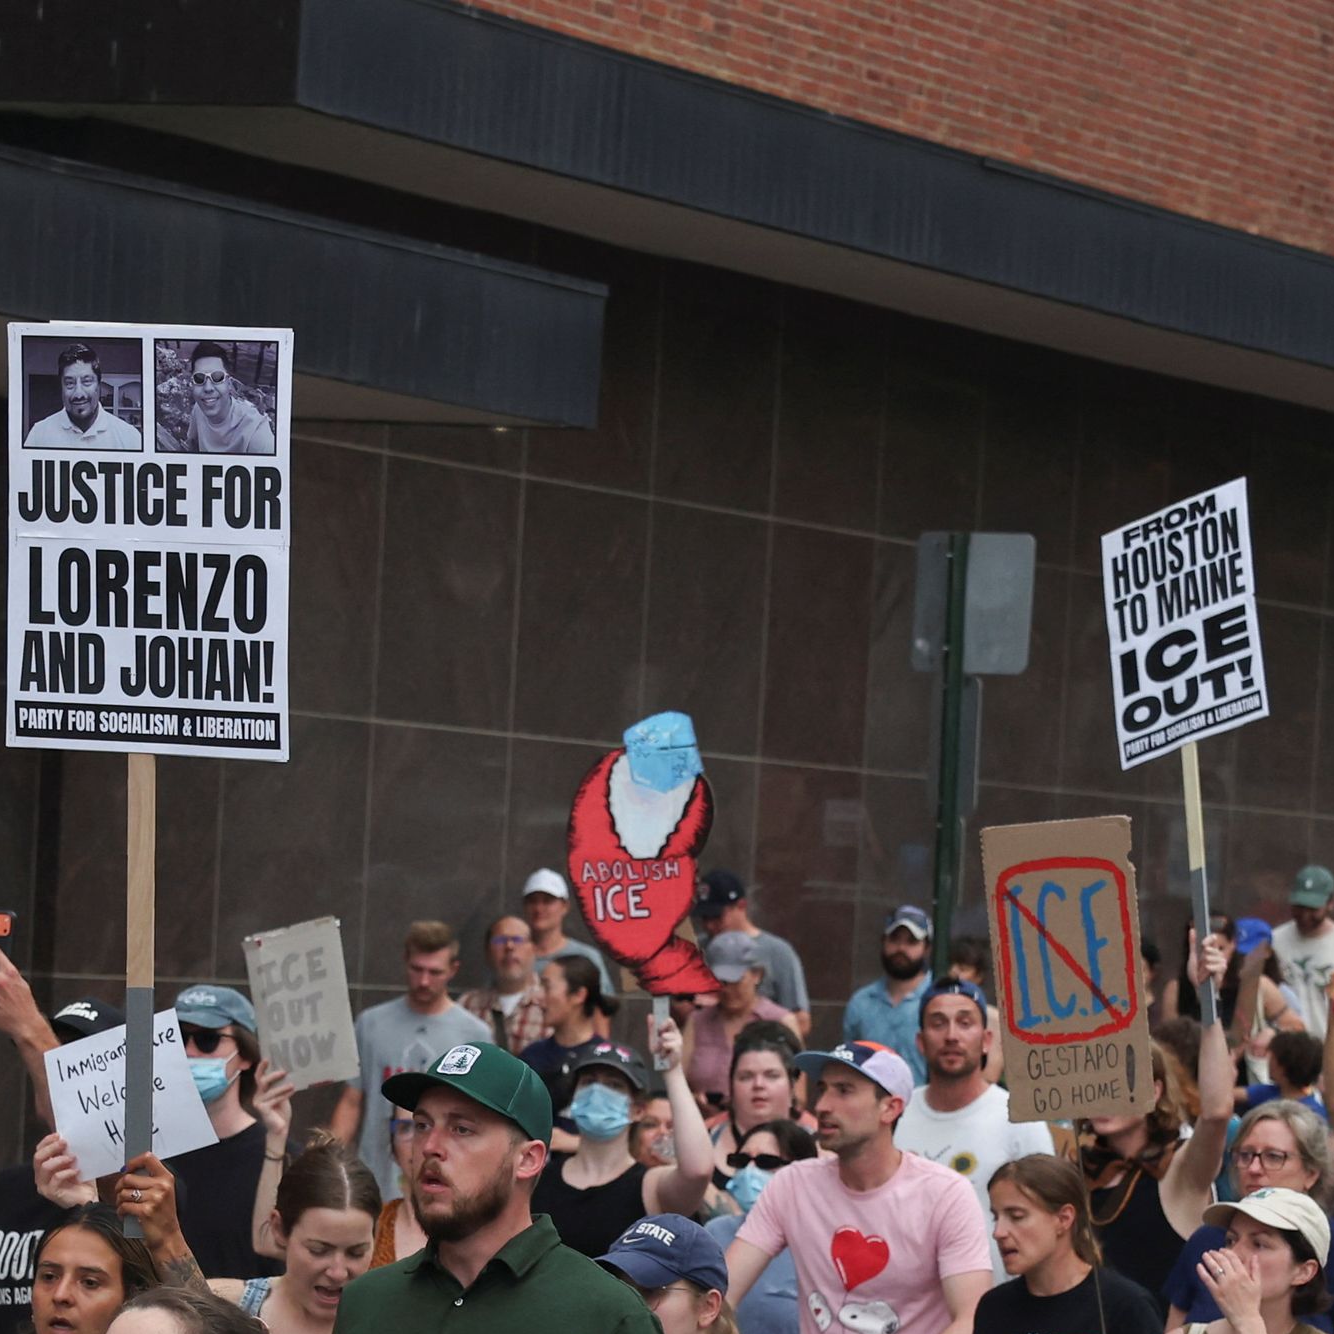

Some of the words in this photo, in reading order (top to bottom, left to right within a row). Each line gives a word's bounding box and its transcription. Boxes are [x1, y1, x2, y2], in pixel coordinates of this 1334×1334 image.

[18, 459, 188, 527] JUSTICE
[202, 464, 282, 529] FOR
[1122, 493, 1217, 549] FROM
[1112, 507, 1239, 598] HOUSTON
[28, 546, 268, 634] LORENZO
[1114, 592, 1147, 642] TO
[1156, 552, 1246, 628] MAINE
[19, 630, 105, 695] AND
[120, 635, 275, 703] JOHAN!
[1119, 604, 1250, 697] ICE
[1122, 655, 1254, 733] OUT!
[19, 706, 63, 731] PARTY
[67, 709, 96, 733] FOR
[99, 711, 178, 737] SOCIALISM
[182, 717, 192, 737] &
[195, 716, 276, 742] LIBERATION
[1125, 736, 1149, 758] PARTY
[1150, 729, 1166, 749] FOR
[1166, 715, 1206, 741] SOCIALISM
[1207, 711, 1214, 724] &
[1215, 694, 1261, 722] LIBERATION
[582, 861, 679, 882] ABOLISH
[594, 884, 650, 920] ICE
[256, 947, 326, 998] ICE
[267, 991, 323, 1032] OUT
[269, 1032, 336, 1073] NOW
[1027, 1042, 1119, 1080] GESTAPO
[1033, 1088, 1062, 1113] GO
[635, 1222, 676, 1247] STATE
